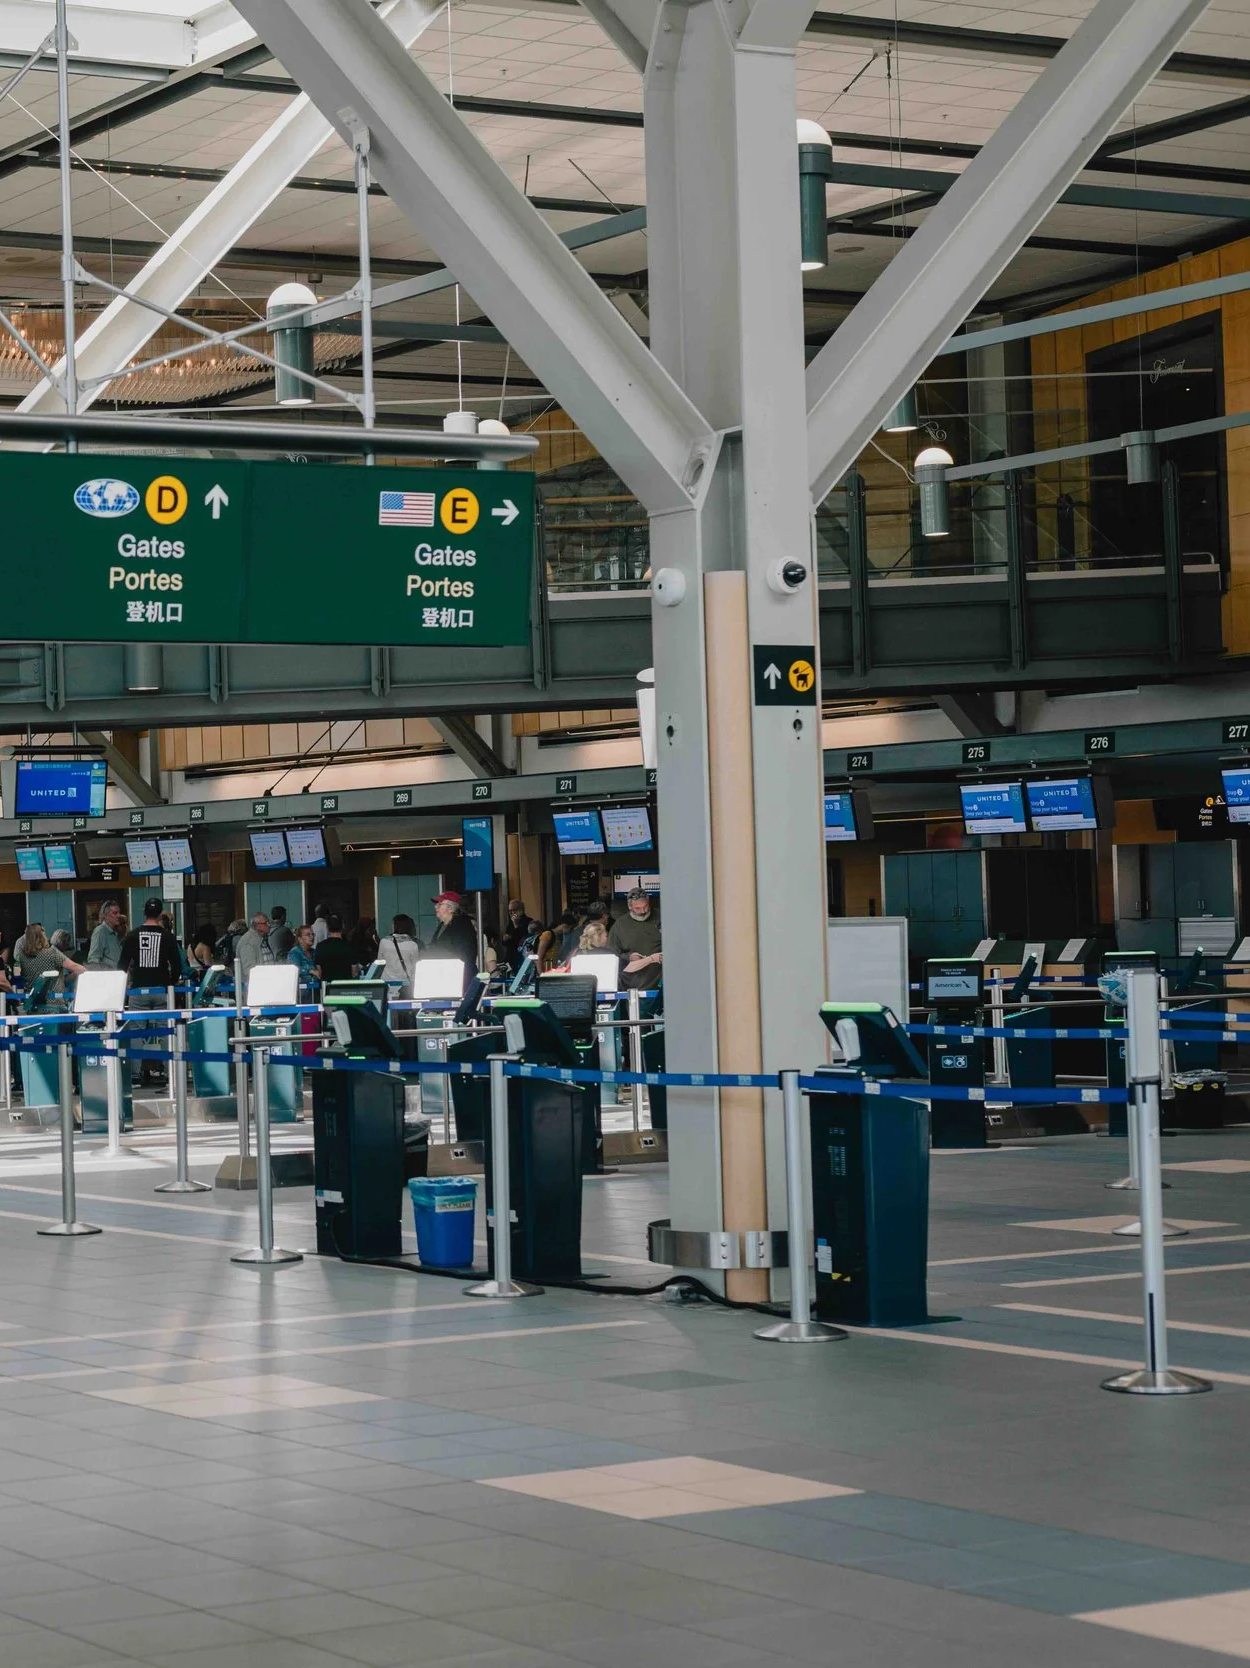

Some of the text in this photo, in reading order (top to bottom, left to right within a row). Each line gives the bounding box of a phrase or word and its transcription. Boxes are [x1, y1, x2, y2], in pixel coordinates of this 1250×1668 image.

[157, 486, 178, 513] D
[450, 498, 469, 523] E
[118, 534, 184, 560] Gates
[414, 544, 476, 568] Gates
[109, 567, 183, 592] Portes
[406, 574, 474, 598] Portes
[126, 601, 183, 624] 登机口
[422, 607, 474, 629] 登机口
[1228, 725, 1248, 738] 277
[1090, 736, 1108, 748] 276
[968, 748, 984, 758] 275
[852, 756, 868, 766] 274
[476, 786, 488, 796] 270
[560, 780, 572, 790] 271
[324, 800, 335, 808] 268
[396, 794, 408, 803] 269
[256, 805, 265, 814] 267
